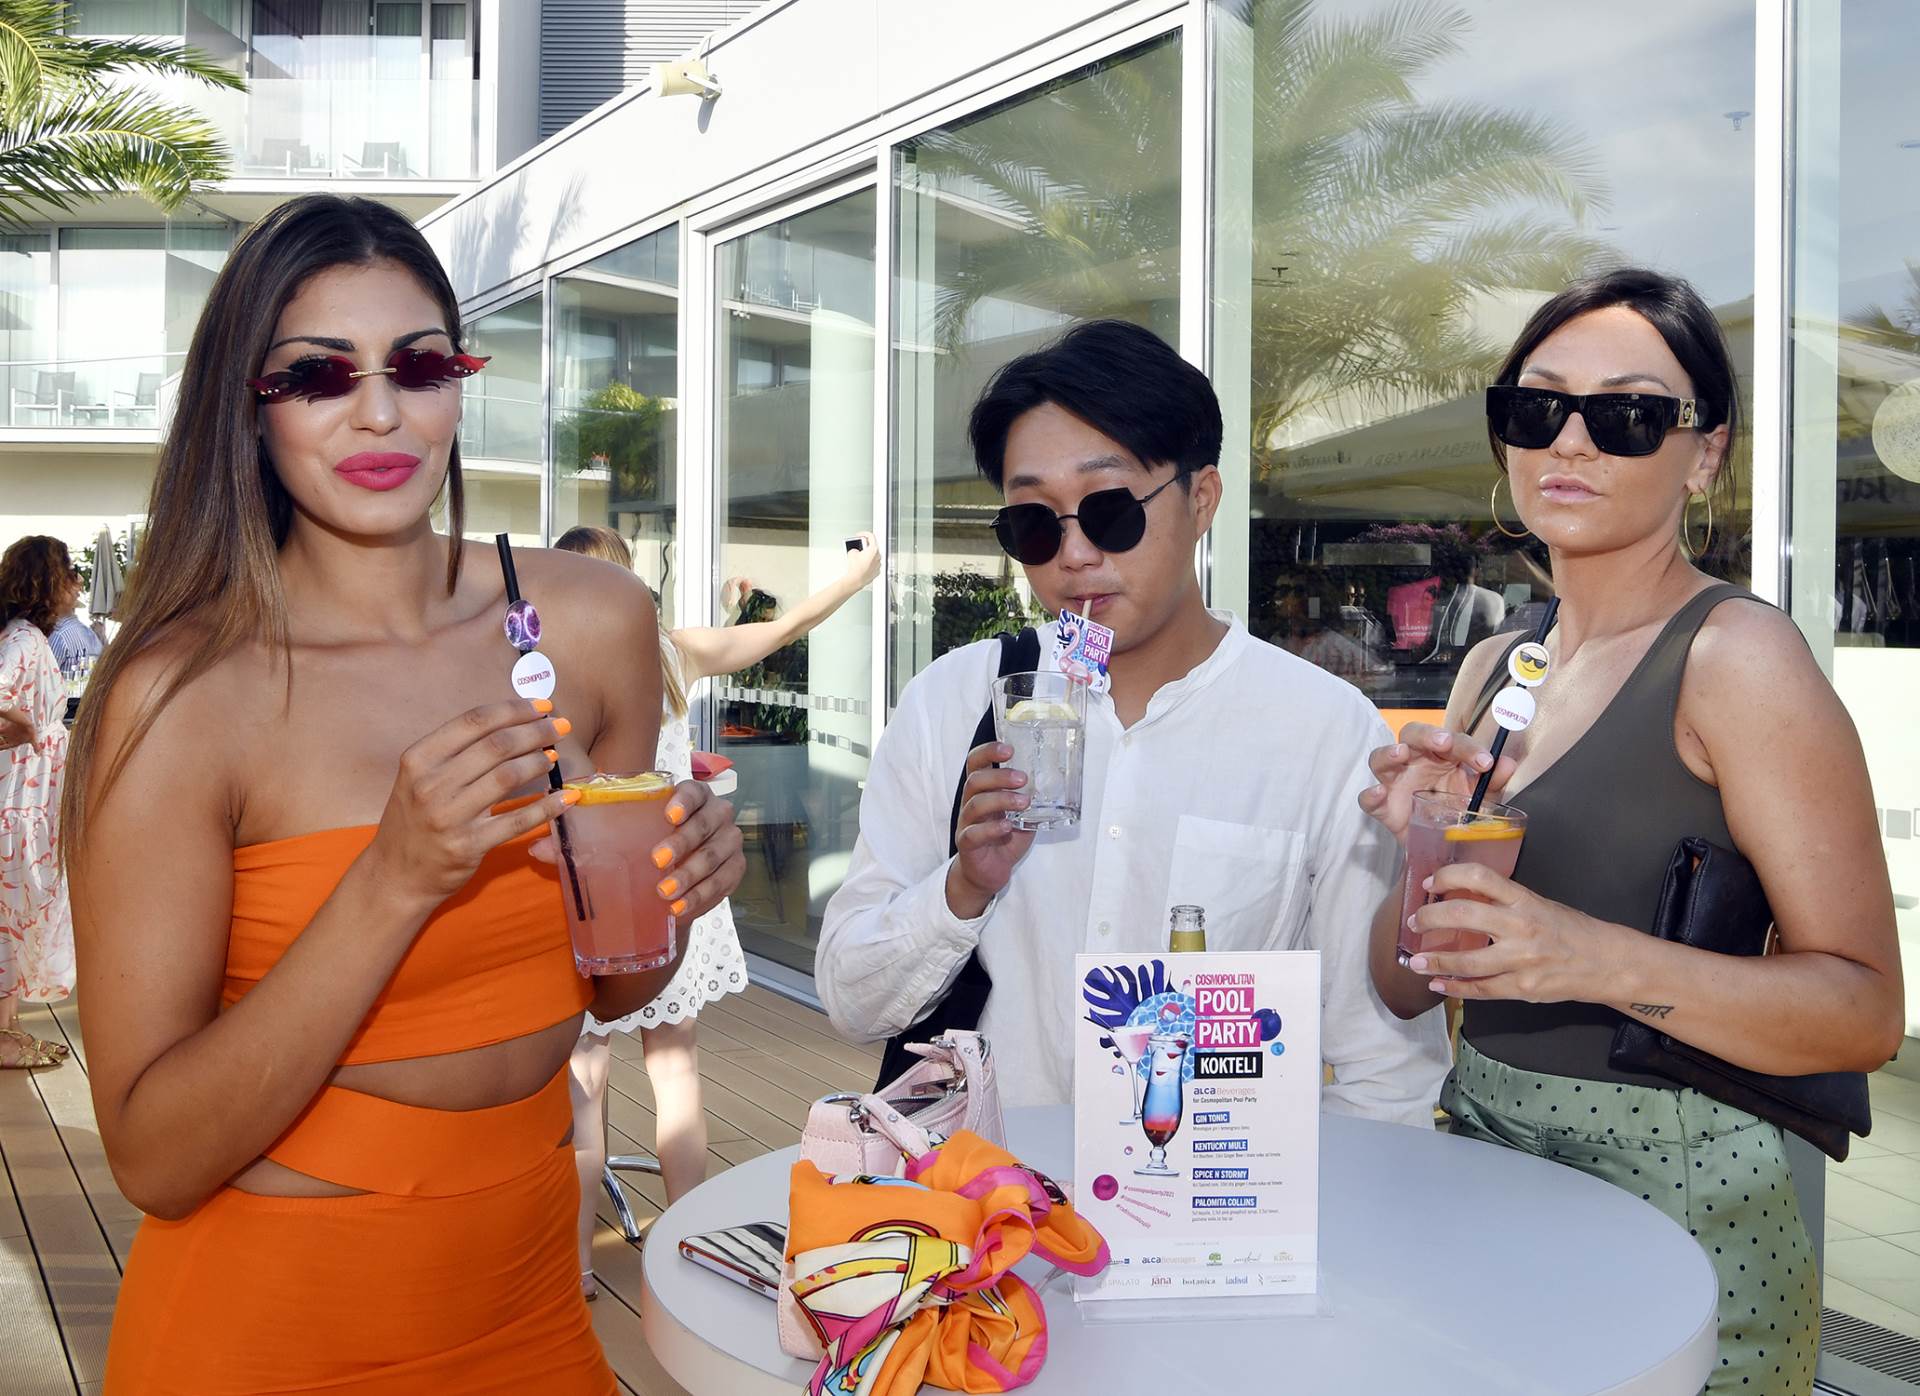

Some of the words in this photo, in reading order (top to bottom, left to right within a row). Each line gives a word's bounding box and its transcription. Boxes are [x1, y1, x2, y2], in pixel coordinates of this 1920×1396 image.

[1086, 630, 1108, 648] POOL
[1083, 645, 1109, 664] PARTY
[1195, 974, 1255, 986] COSMOPOLITAN
[1198, 989, 1251, 1013] POOL
[1198, 1021, 1258, 1045] PARTY
[1200, 1056, 1257, 1075] KOKTELI
[1200, 1096, 1232, 1104] Cosmopolitan
[1195, 1114, 1207, 1123] GIN
[1208, 1113, 1228, 1122] TONIC
[1194, 1141, 1228, 1151] KENTUCKY
[1228, 1141, 1247, 1150] MULE
[1194, 1169, 1213, 1179] SPICE
[1214, 1169, 1220, 1179] N
[1220, 1169, 1247, 1179] STORMY
[1194, 1198, 1227, 1207] PALOMITA
[1227, 1198, 1255, 1207] COLLINS
